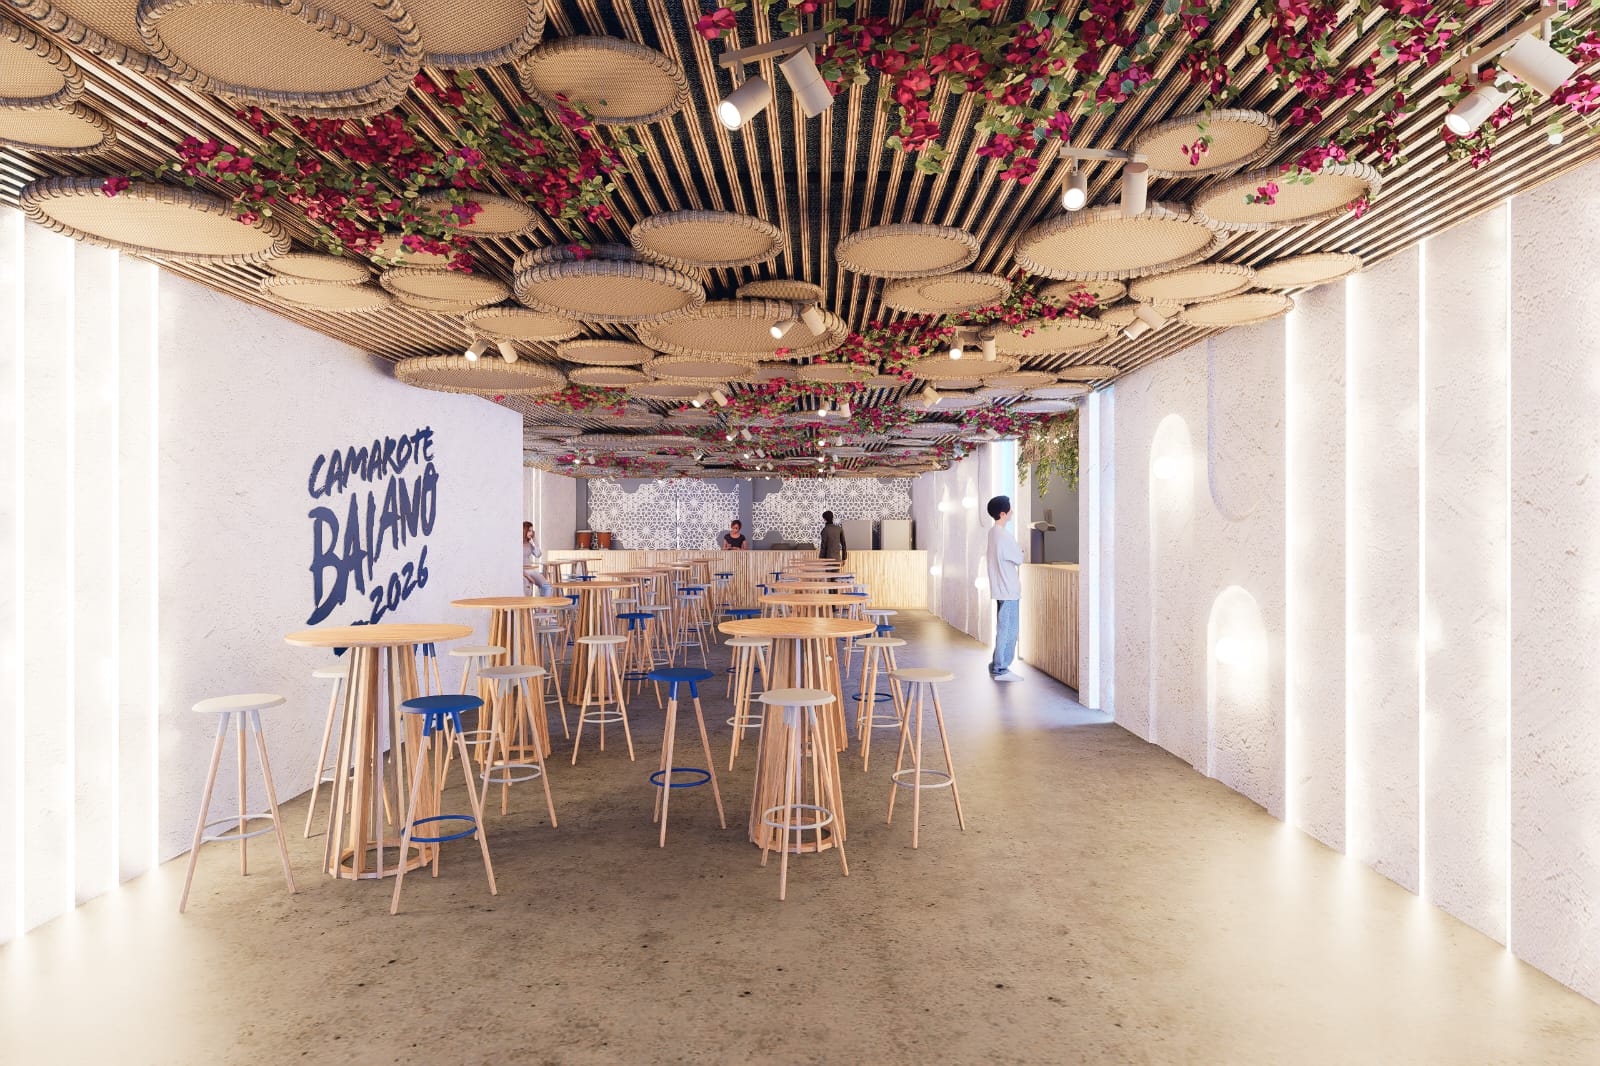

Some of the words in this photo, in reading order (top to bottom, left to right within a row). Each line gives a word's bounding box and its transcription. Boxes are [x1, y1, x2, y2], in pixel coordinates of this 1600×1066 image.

[308, 426, 434, 499] CAMAROTE
[306, 462, 438, 625] BAIANO
[370, 545, 429, 624] 2026
